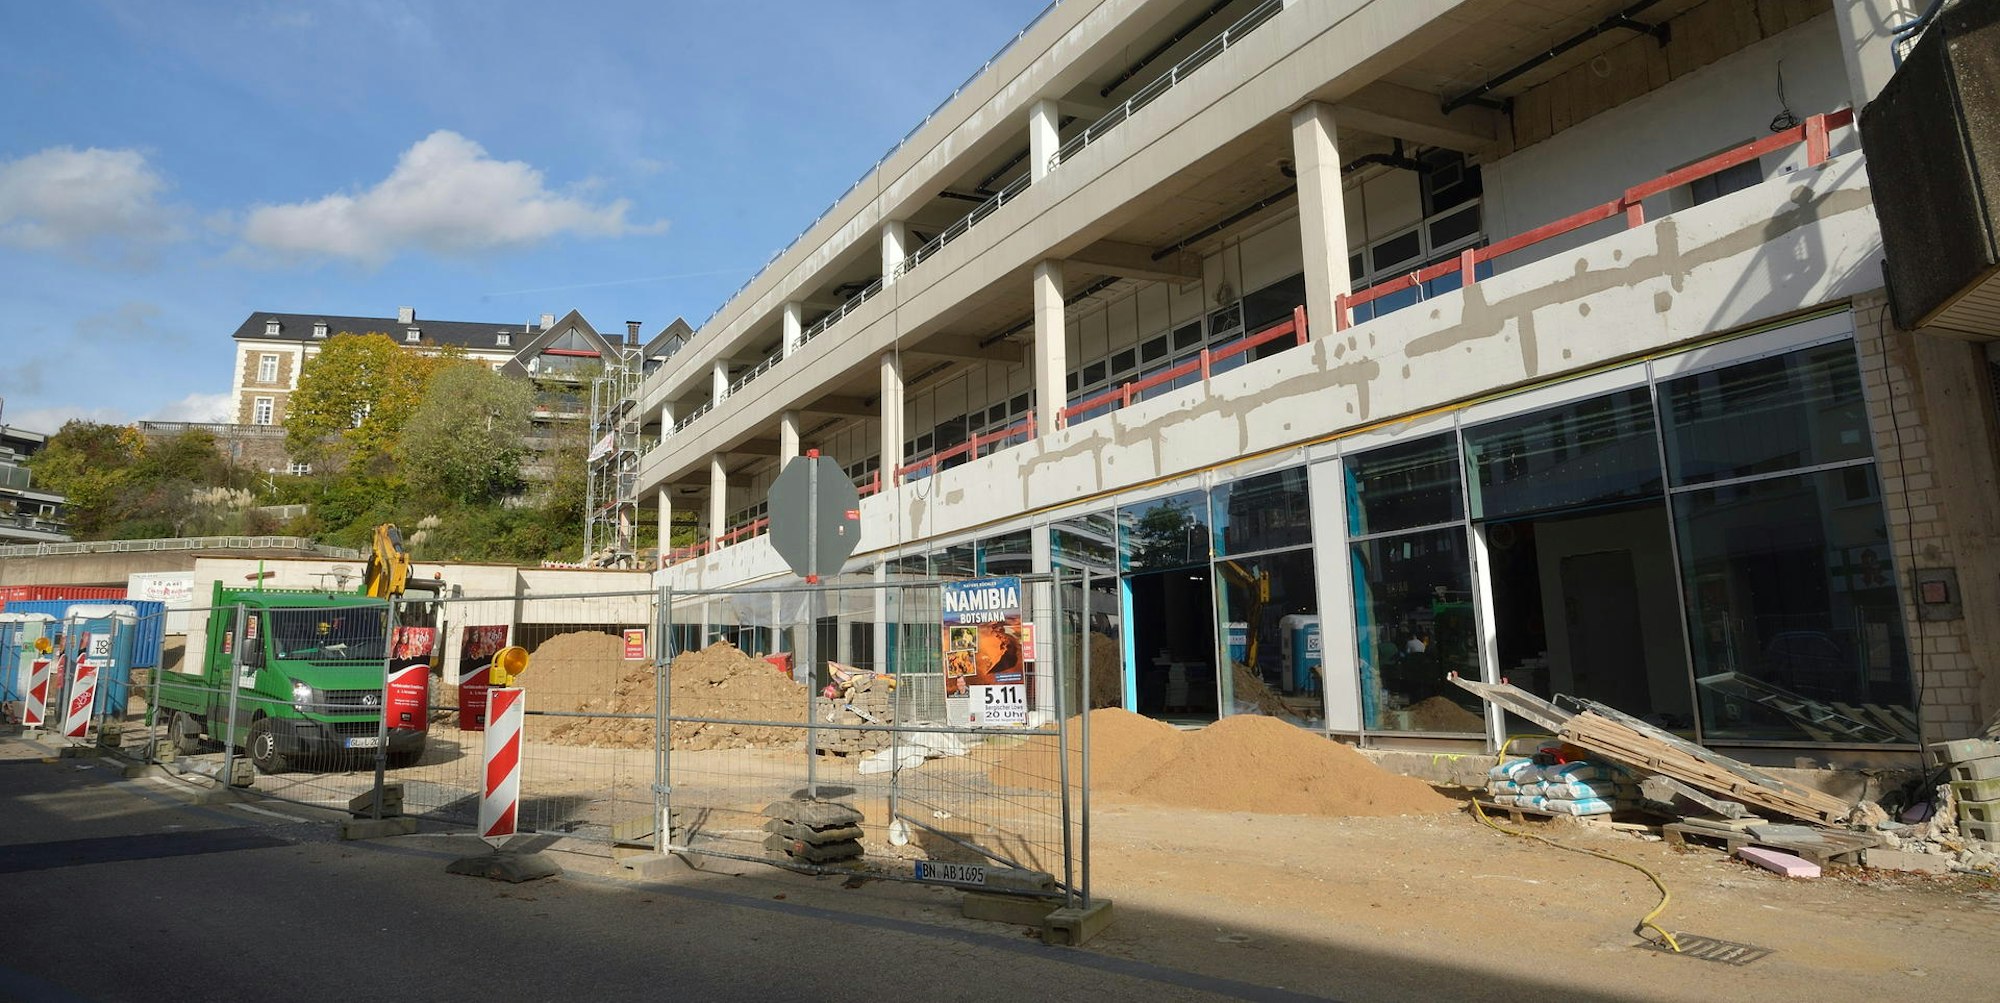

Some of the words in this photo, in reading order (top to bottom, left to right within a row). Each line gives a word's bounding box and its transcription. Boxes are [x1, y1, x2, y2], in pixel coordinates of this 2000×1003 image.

[945, 587, 1019, 612] NAMIBIA
[960, 612, 1005, 624] BOTSWANA
[985, 686, 1023, 704] 5.11.
[922, 863, 936, 878] BN
[943, 864, 957, 880] AB
[959, 866, 984, 882] 1695
